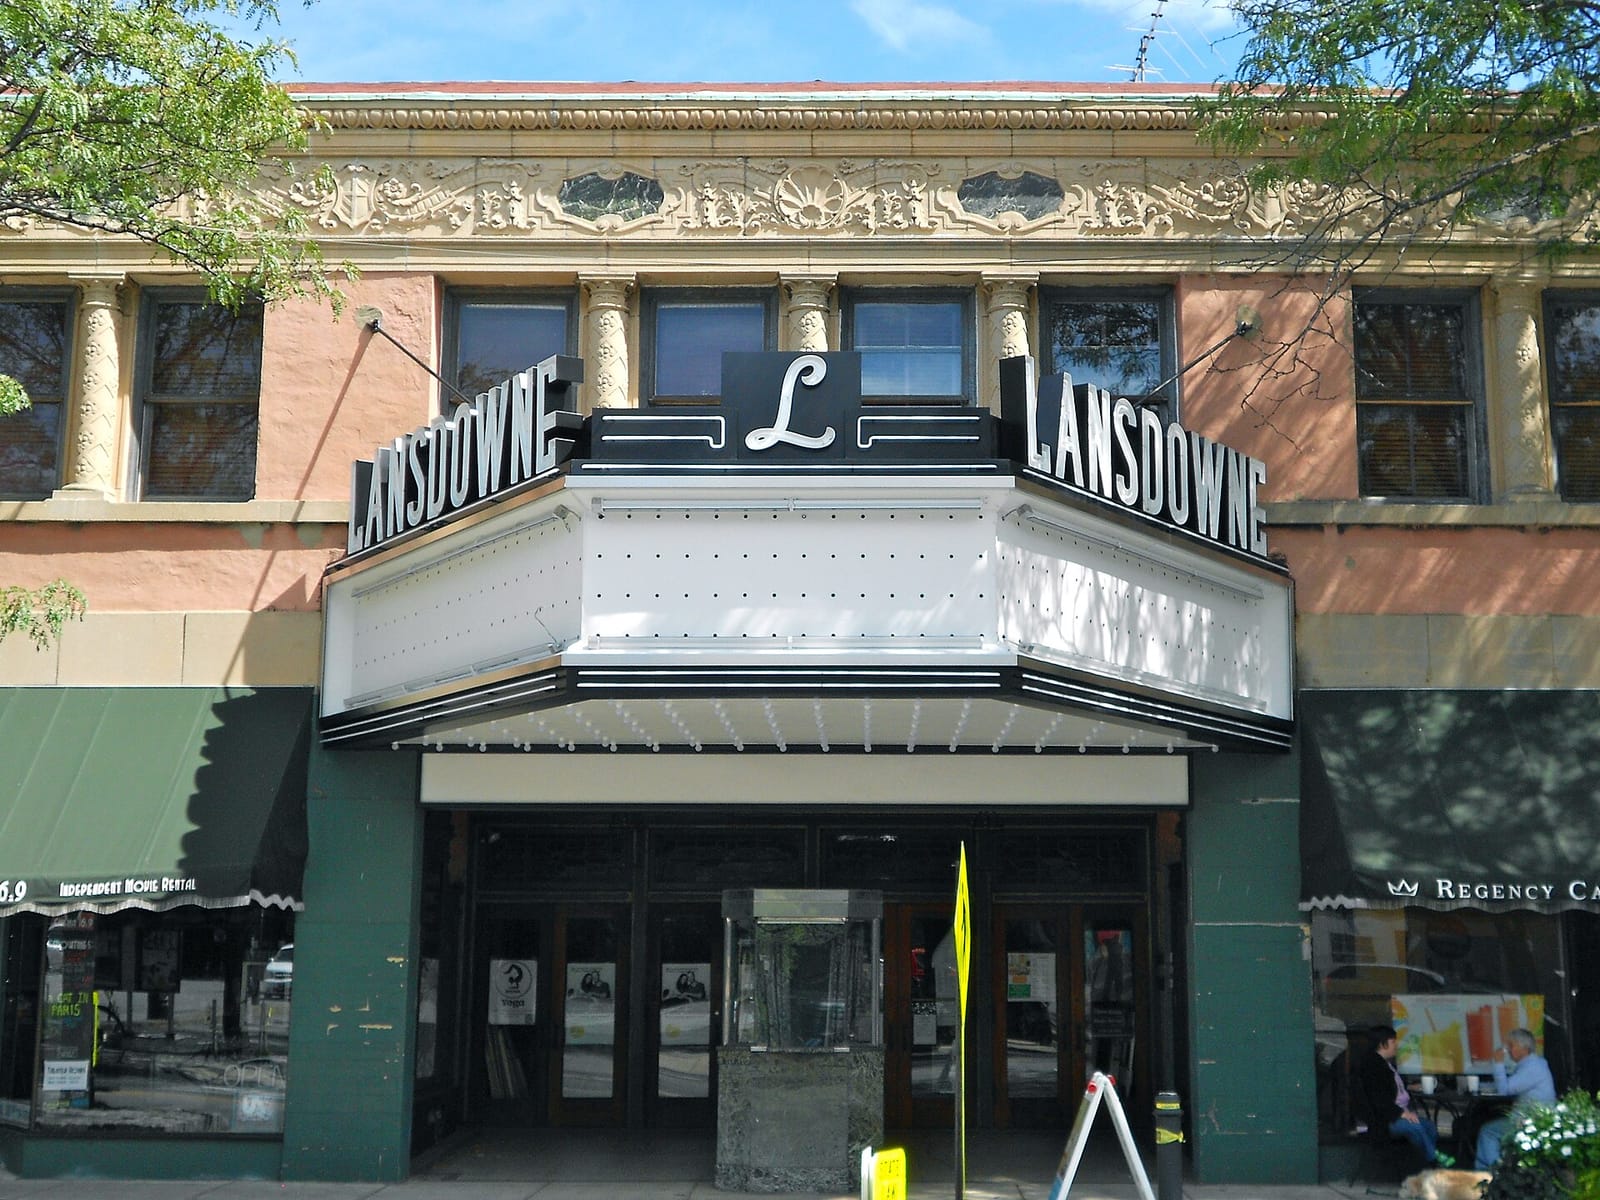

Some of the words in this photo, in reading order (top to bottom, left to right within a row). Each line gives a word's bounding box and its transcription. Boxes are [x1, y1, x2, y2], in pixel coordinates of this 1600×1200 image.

[745, 354, 836, 451] L
[348, 354, 560, 554] LANSDOWNE
[1024, 355, 1268, 557] LANSDOWNE
[59, 881, 122, 897] INDEPENDENT
[124, 878, 159, 894] MOVIE
[161, 876, 197, 892] RENTAL
[1436, 879, 1554, 899] REGENCY
[51, 1004, 80, 1017] PARIS
